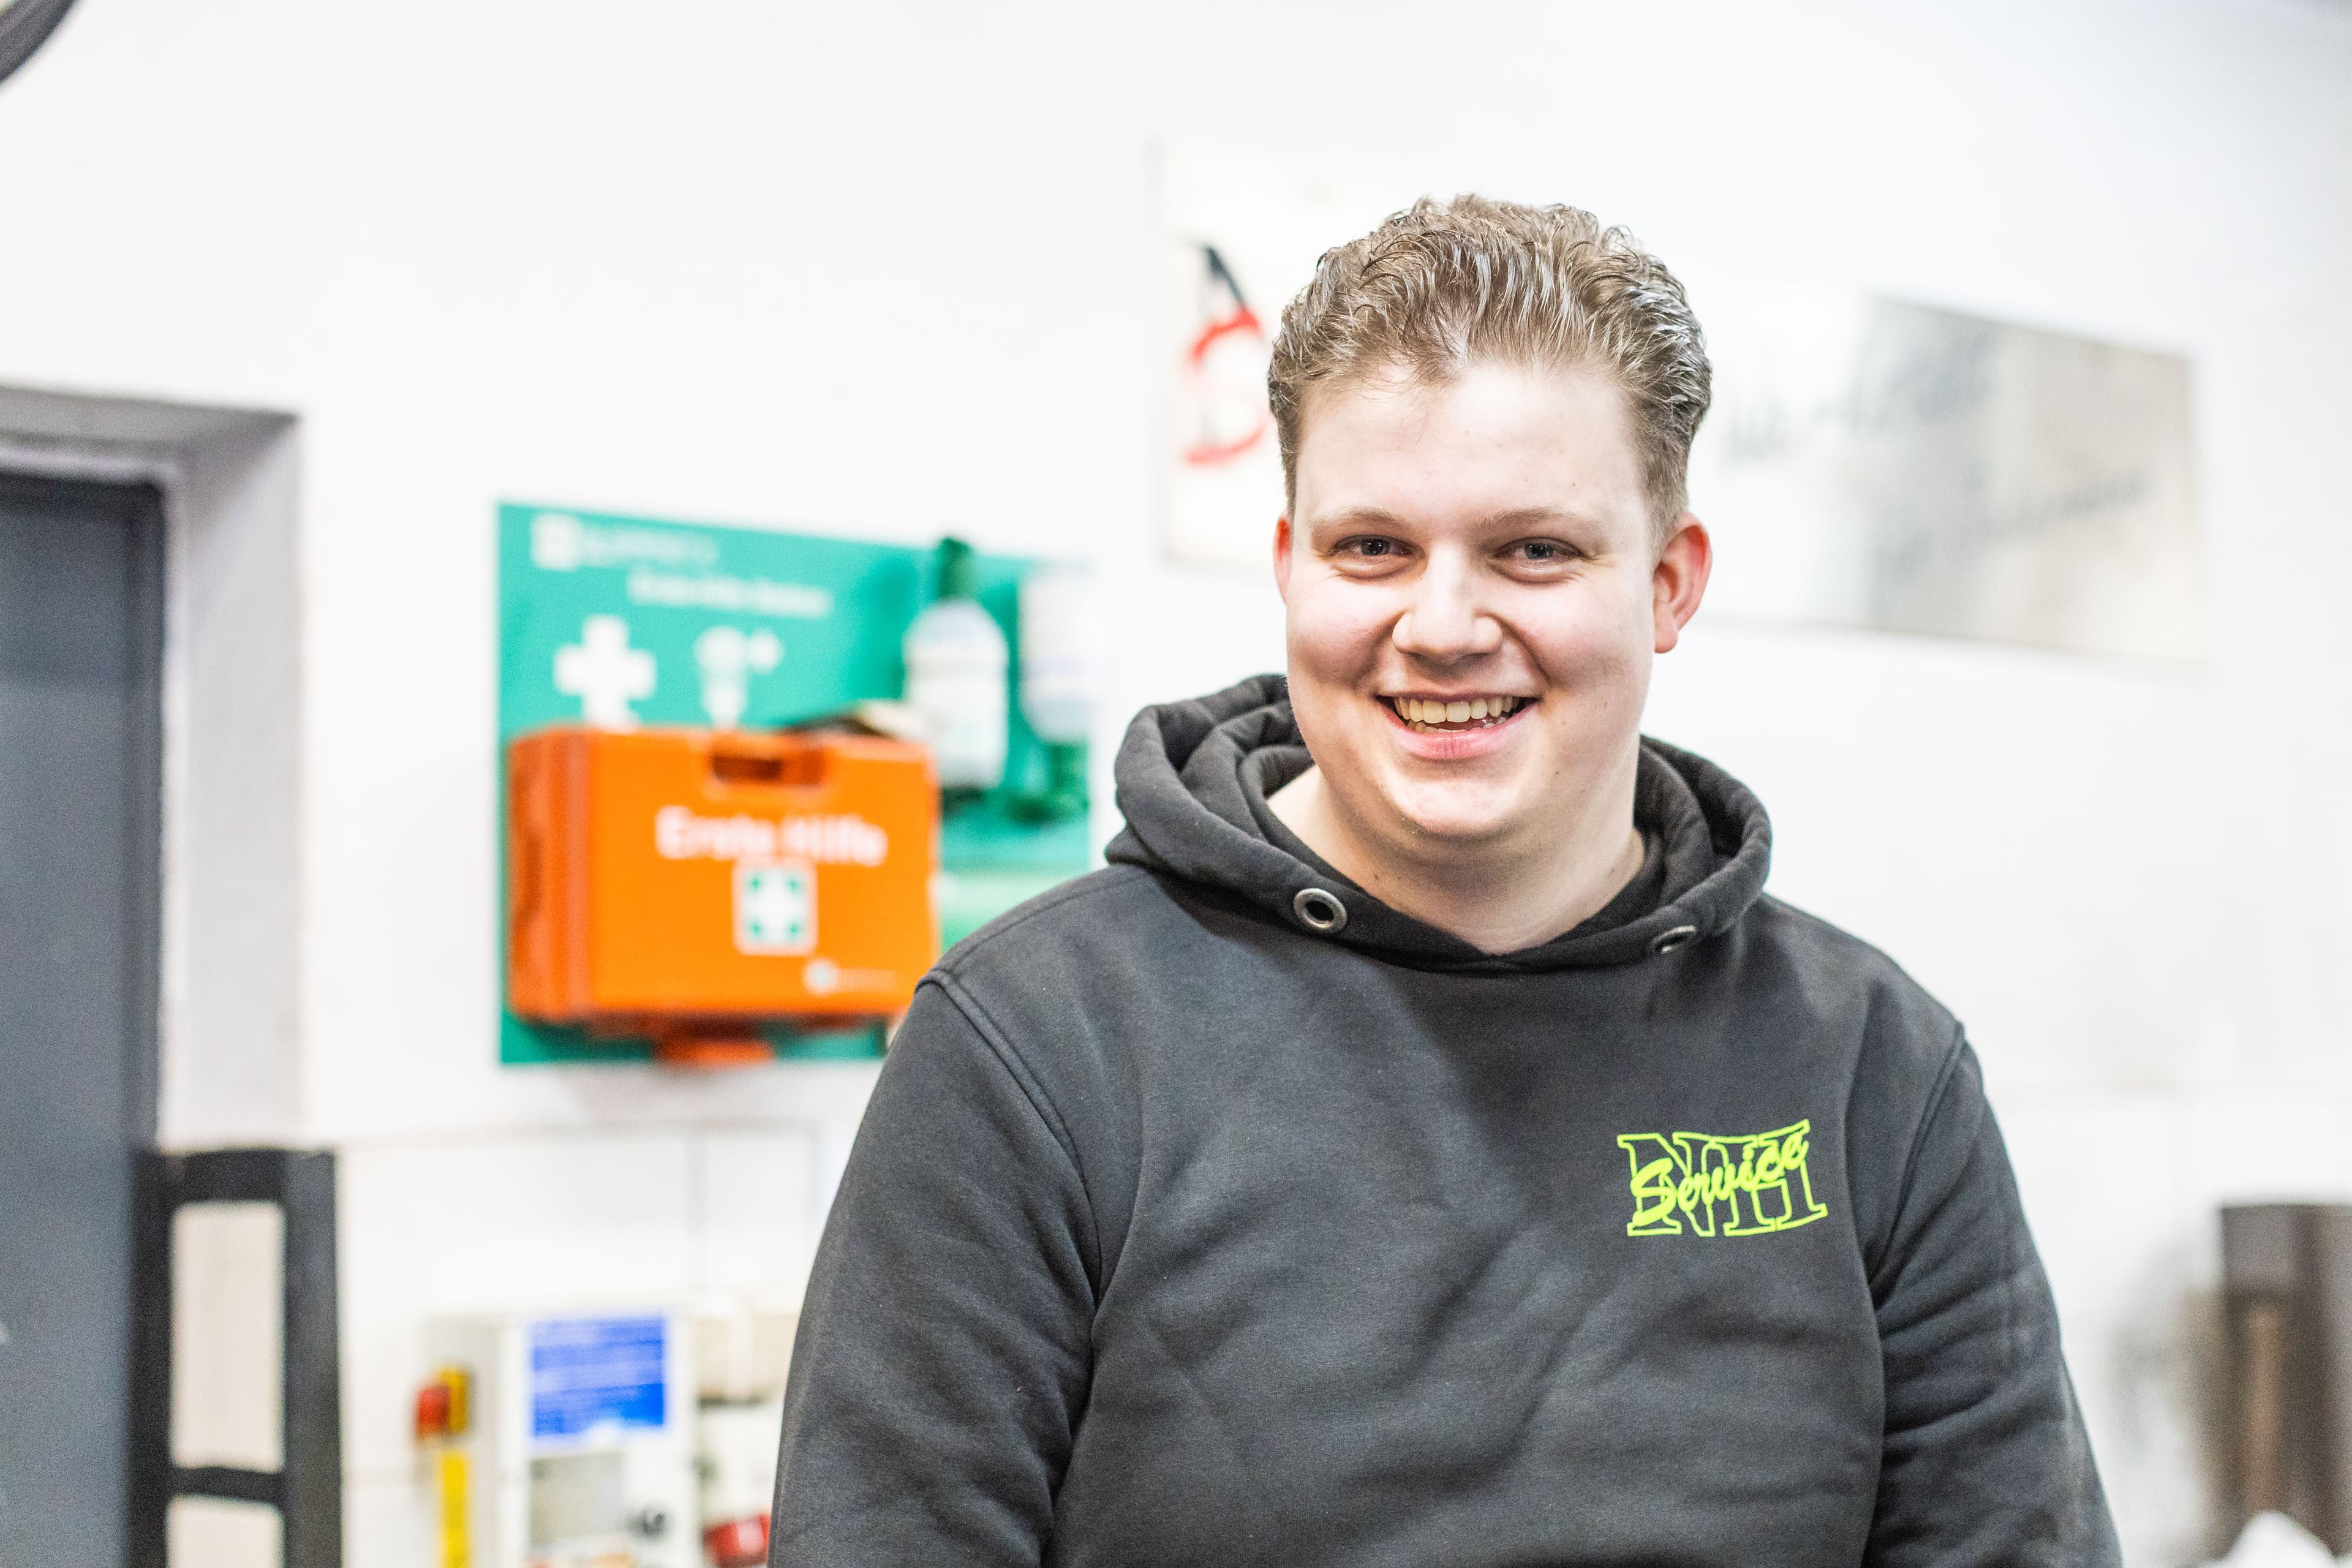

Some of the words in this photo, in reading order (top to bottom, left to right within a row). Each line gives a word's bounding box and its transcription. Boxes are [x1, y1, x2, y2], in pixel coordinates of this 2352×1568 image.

[657, 806, 774, 859] Erste
[779, 813, 888, 867] Hilfe
[1630, 1132, 1810, 1227] Service
